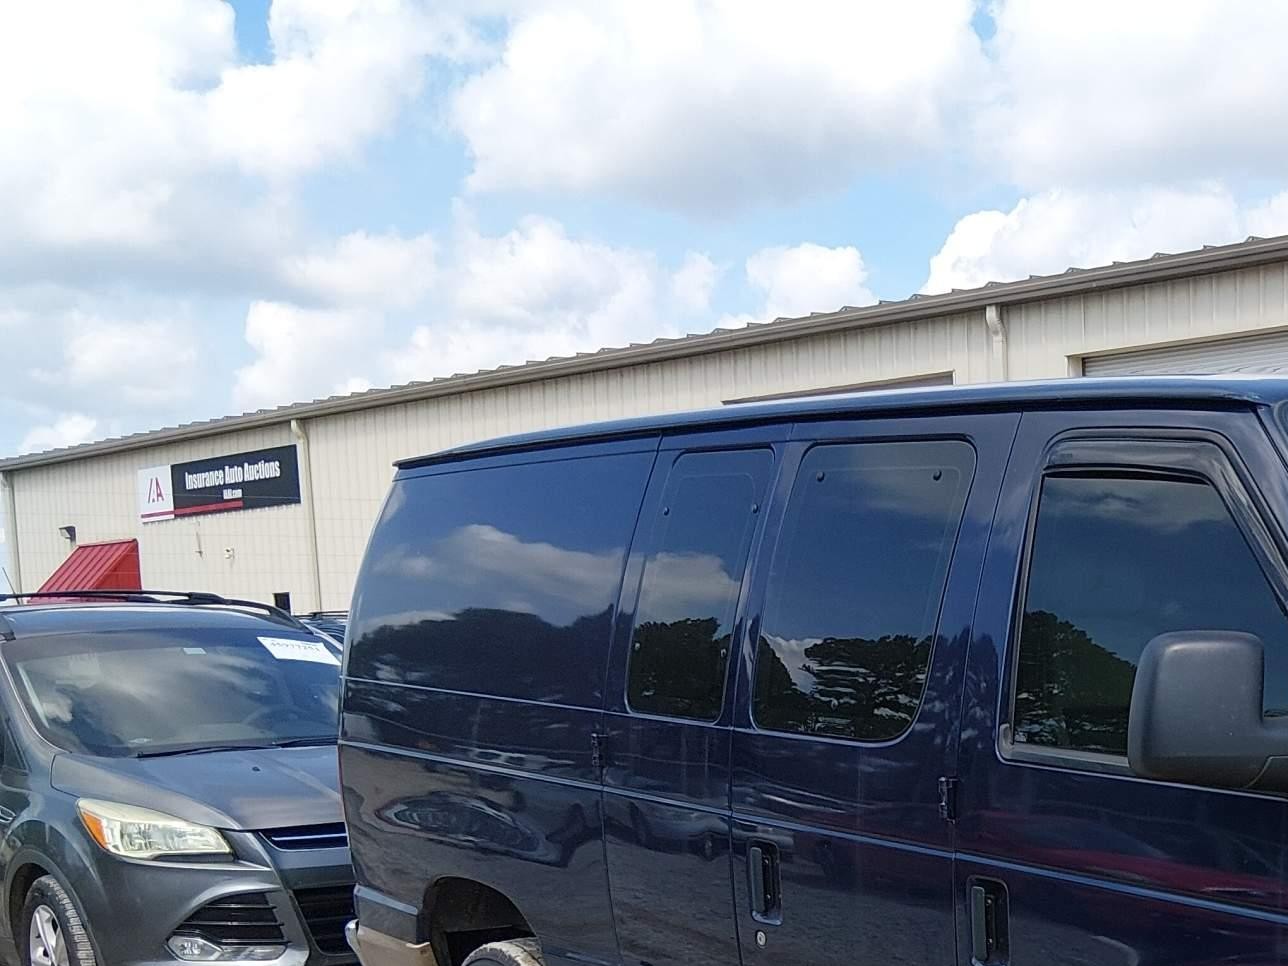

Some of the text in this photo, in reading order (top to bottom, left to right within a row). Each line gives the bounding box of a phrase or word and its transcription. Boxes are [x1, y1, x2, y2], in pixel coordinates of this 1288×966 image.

[185, 460, 281, 490] Insurance Auto Auctions
